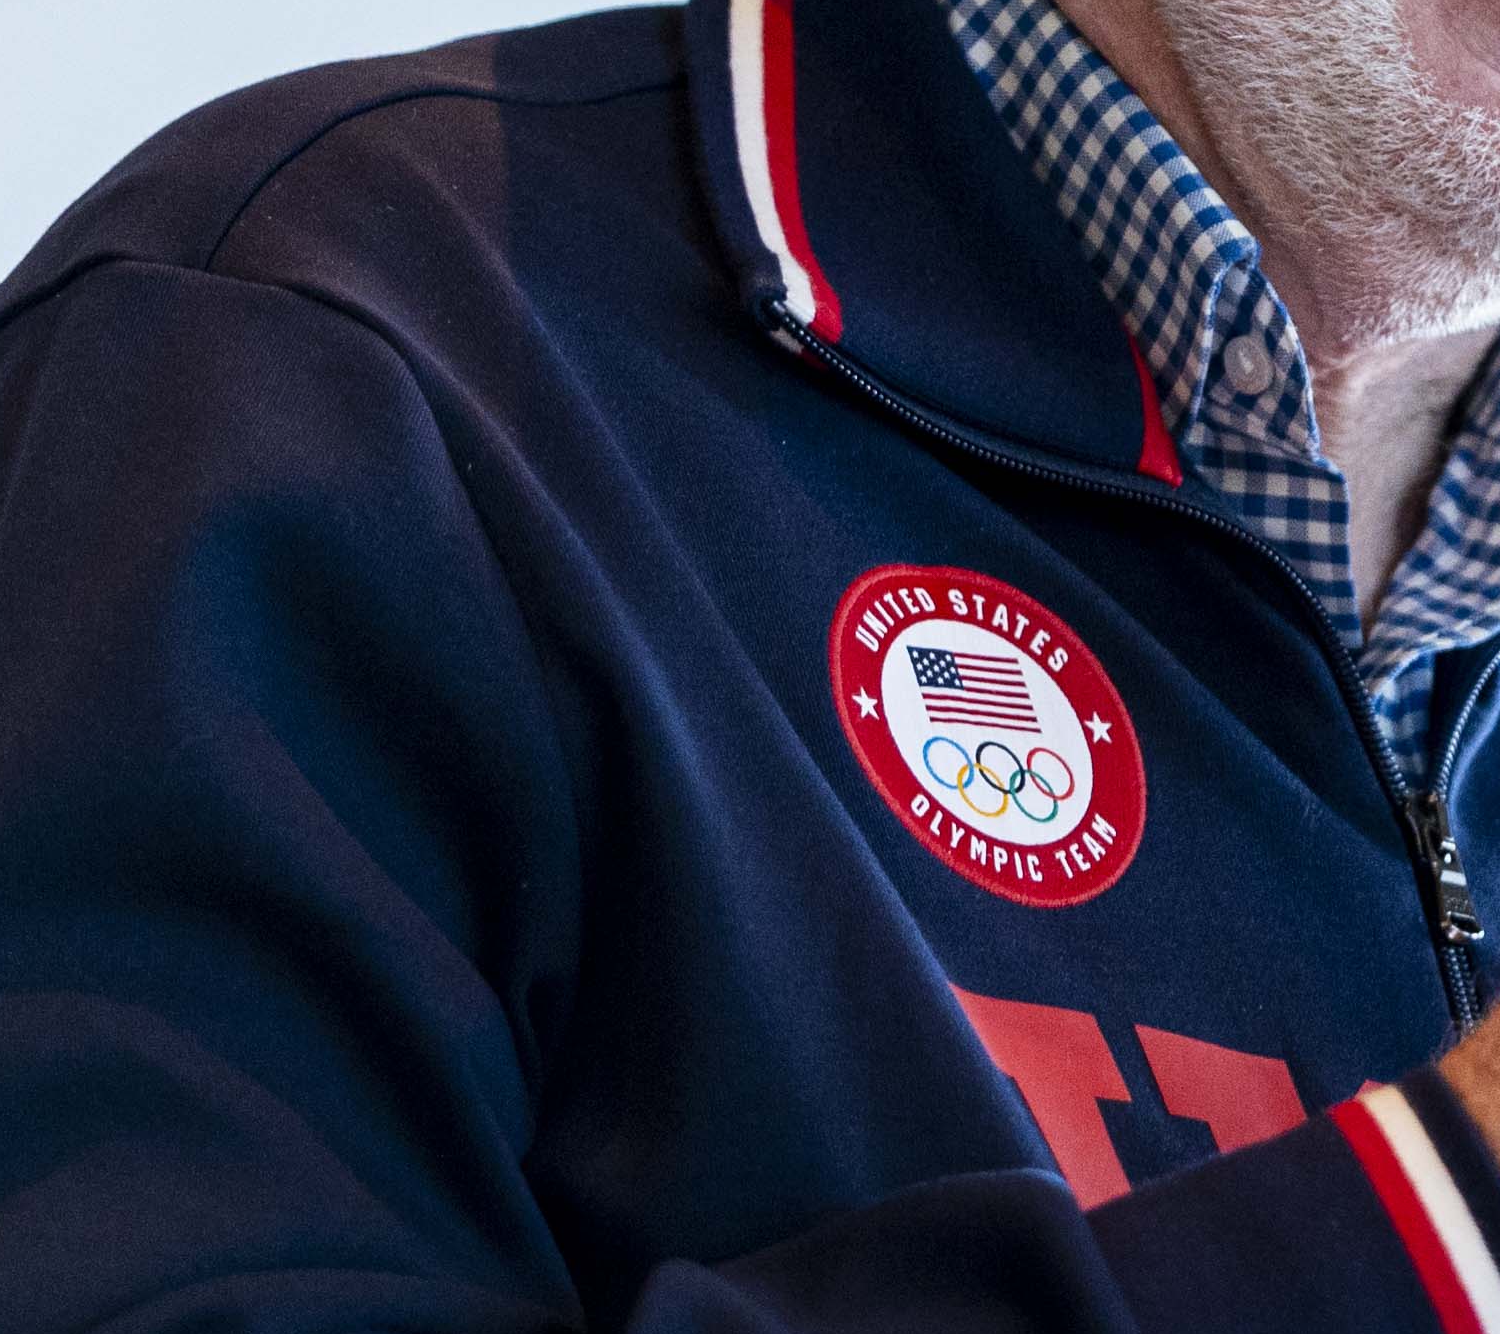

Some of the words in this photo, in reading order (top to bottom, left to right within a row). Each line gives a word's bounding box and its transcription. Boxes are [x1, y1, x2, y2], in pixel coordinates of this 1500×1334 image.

[855, 586, 937, 653] UNITED
[947, 588, 1069, 673] STATES
[909, 793, 1044, 882] OLYMPIC
[1054, 812, 1118, 879] TEAM
